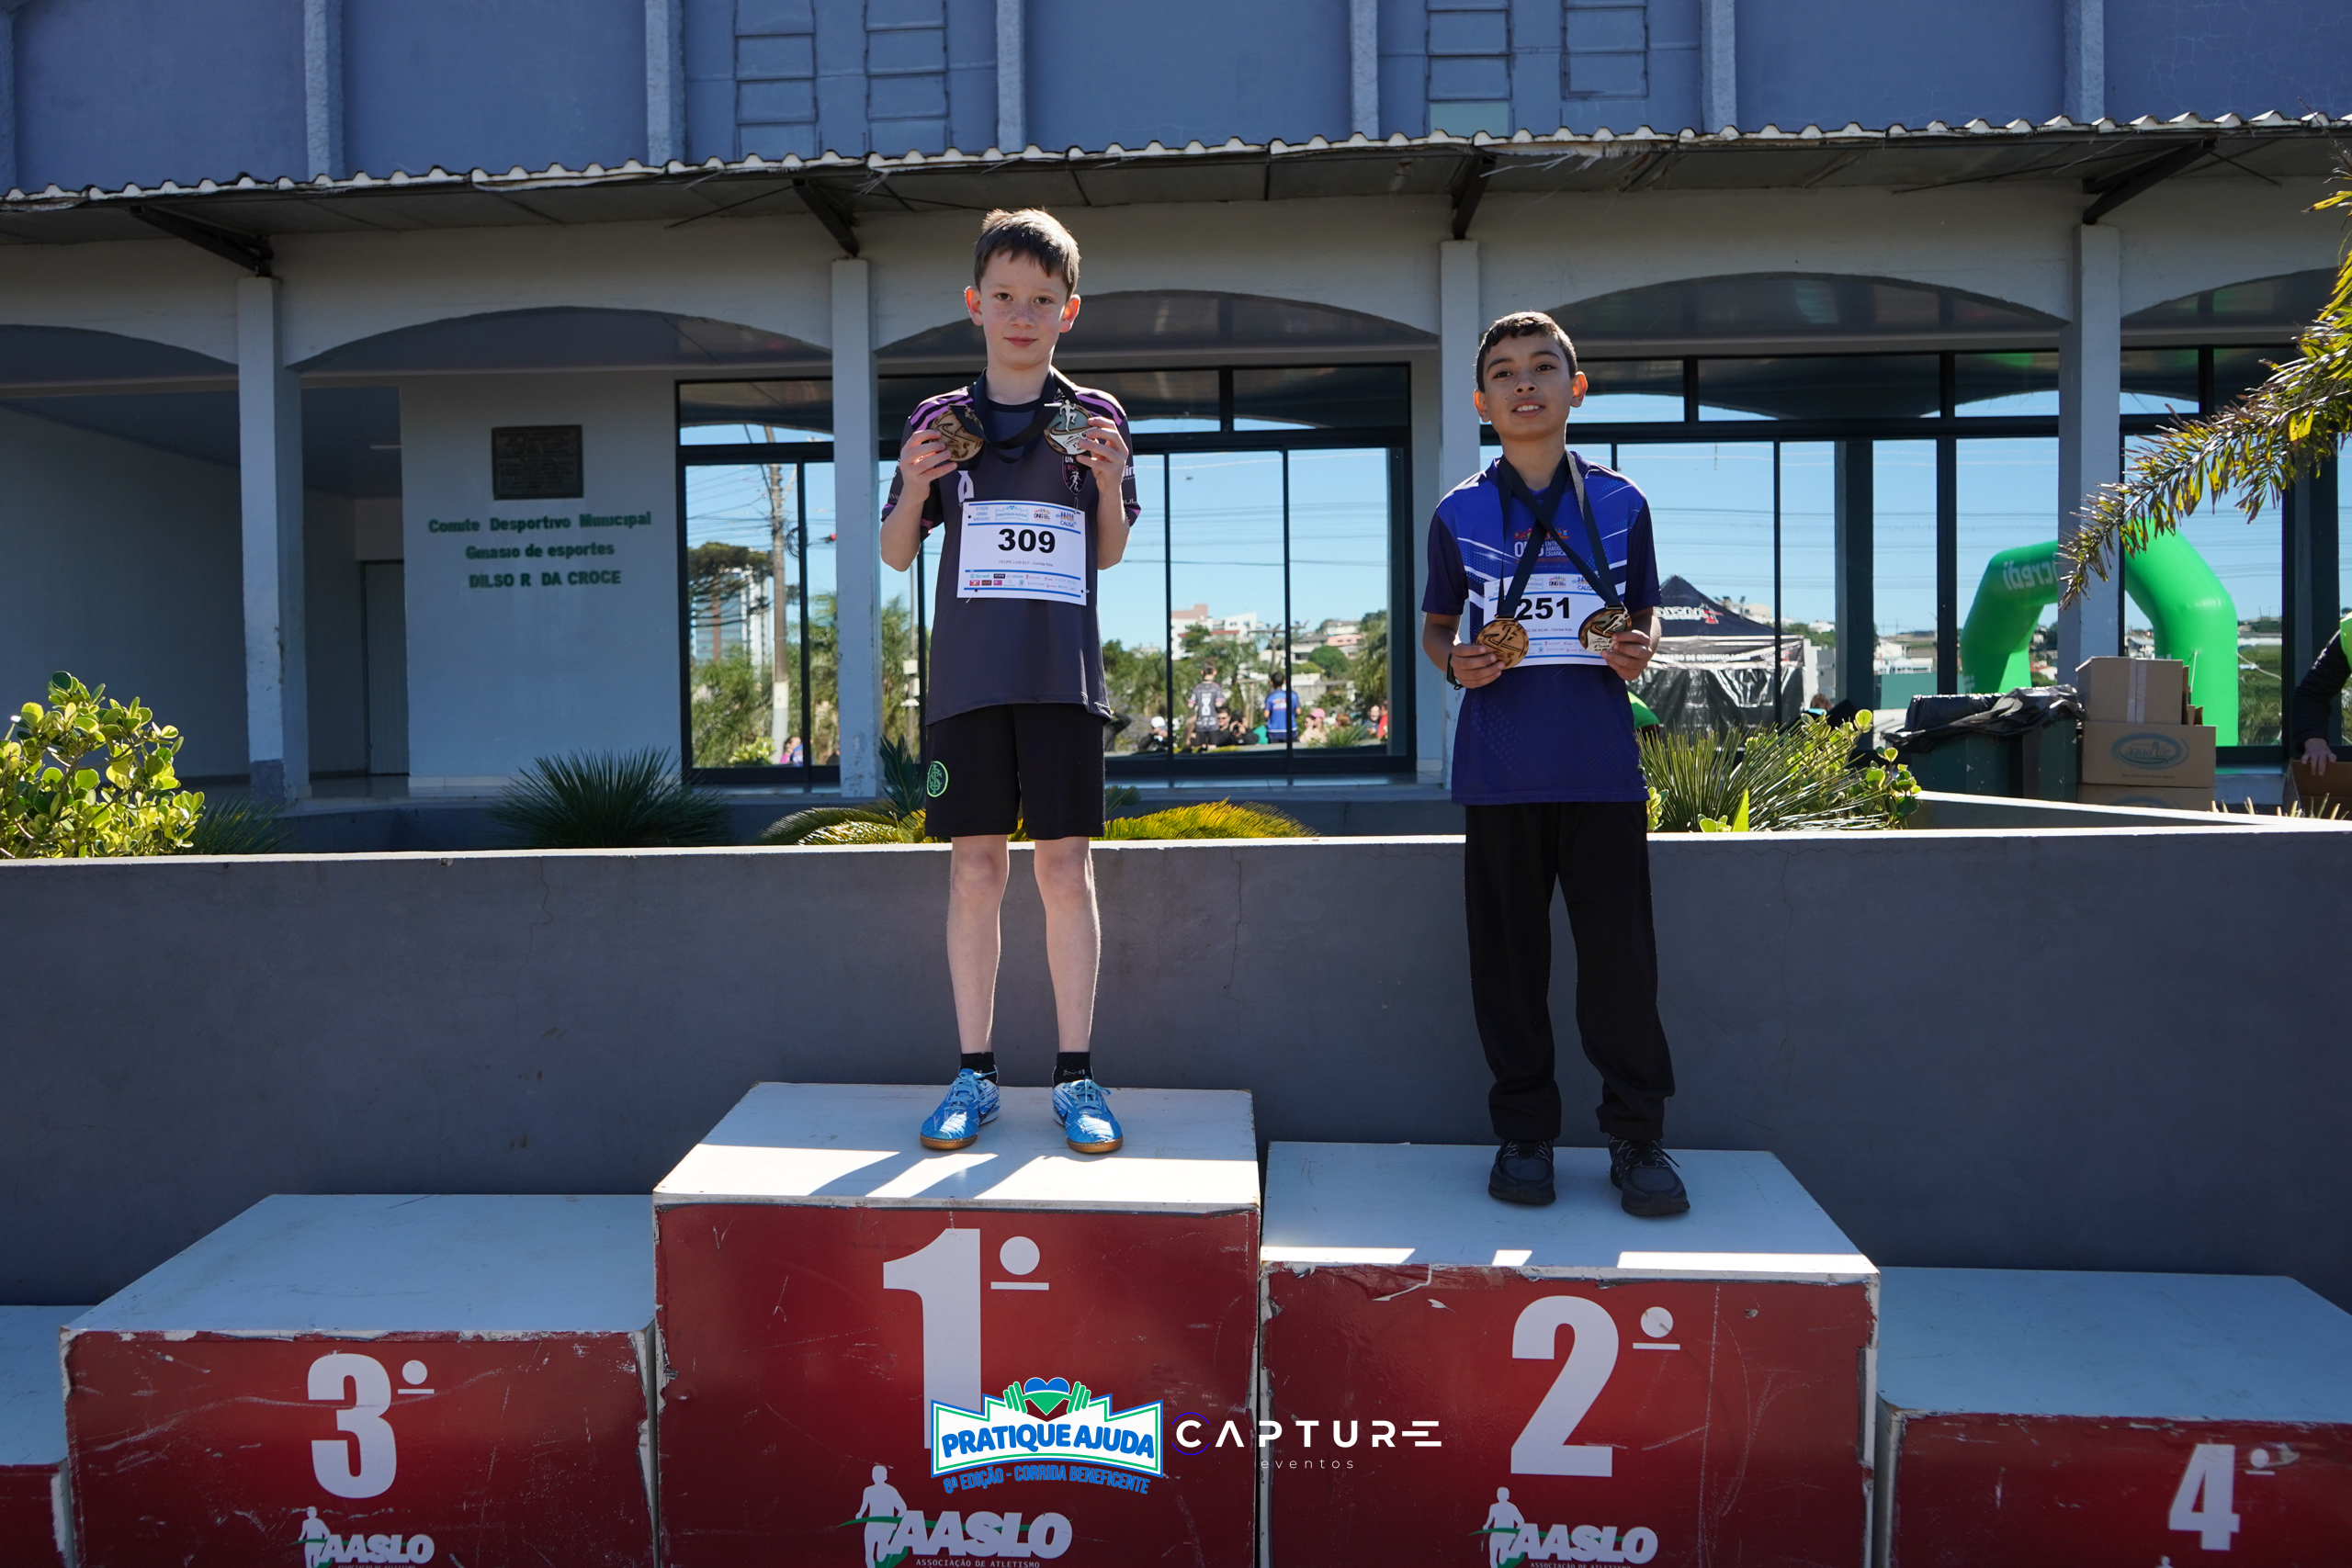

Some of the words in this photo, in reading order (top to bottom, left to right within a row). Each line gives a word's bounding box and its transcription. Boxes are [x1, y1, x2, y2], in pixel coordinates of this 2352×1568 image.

[490, 515, 571, 534] Desportivo
[579, 512, 651, 528] Municipal
[525, 544, 543, 558] de
[548, 542, 615, 559] esportes
[998, 528, 1056, 554] 309
[469, 573, 514, 589] DILSO
[542, 571, 562, 587] DA
[568, 570, 622, 586] CROCE
[1516, 597, 1570, 621] 251
[886, 1510, 1073, 1559] AASLO
[1507, 1523, 1659, 1565] AASLO
[319, 1534, 435, 1564] AASLO
[915, 1558, 972, 1568] ASSOCIAÇÃO
[975, 1560, 987, 1568] DE
[989, 1560, 1041, 1568] ATLETISMO
